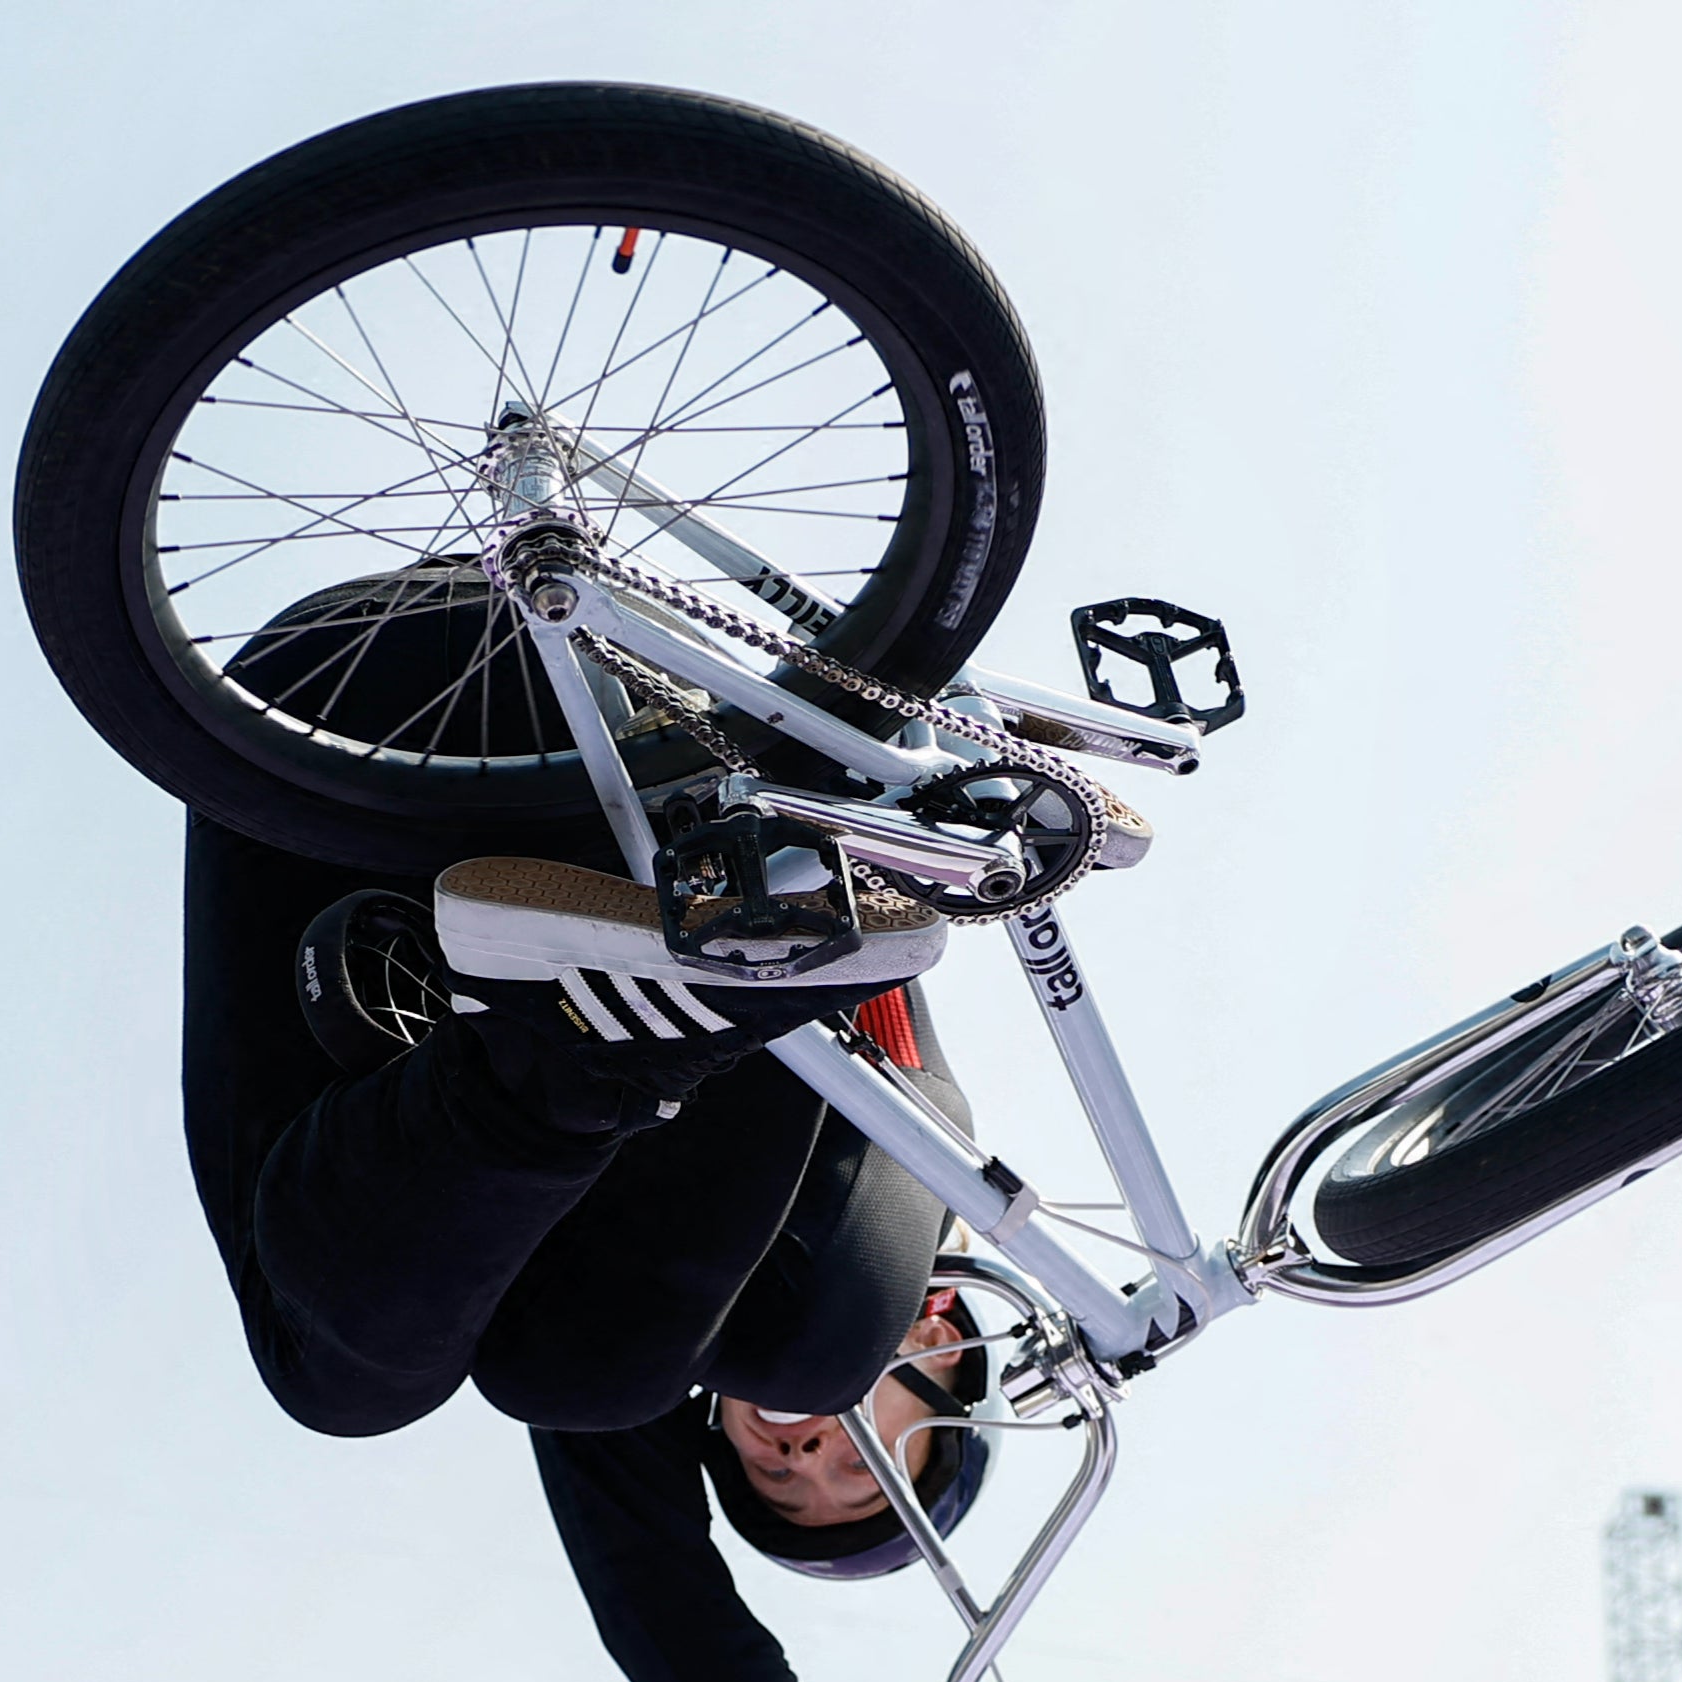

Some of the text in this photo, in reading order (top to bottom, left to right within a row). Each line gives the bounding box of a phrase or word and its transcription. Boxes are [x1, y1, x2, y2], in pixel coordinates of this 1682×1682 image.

[957, 397, 987, 425] tall
[965, 423, 994, 477] order
[301, 946, 322, 1002] tall order
[1023, 945, 1083, 1011] tall
[558, 998, 589, 1033] BUSENITZ
